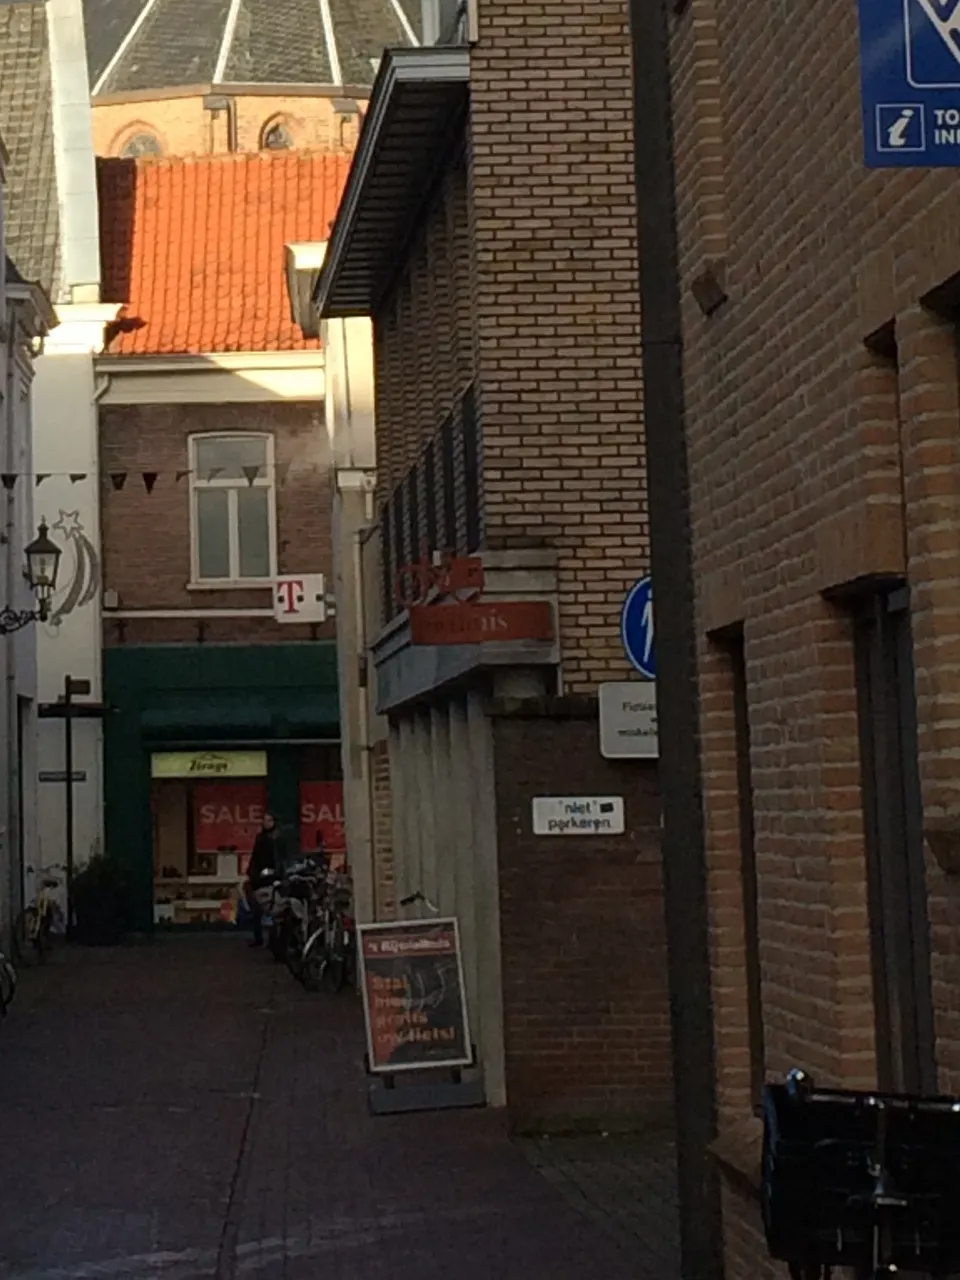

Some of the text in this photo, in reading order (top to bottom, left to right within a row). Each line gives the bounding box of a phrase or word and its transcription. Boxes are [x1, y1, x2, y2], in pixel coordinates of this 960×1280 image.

[933, 109, 960, 125] TO
[200, 804, 264, 824] SALE
[565, 802, 592, 814] niet
[548, 817, 611, 831] parkeren
